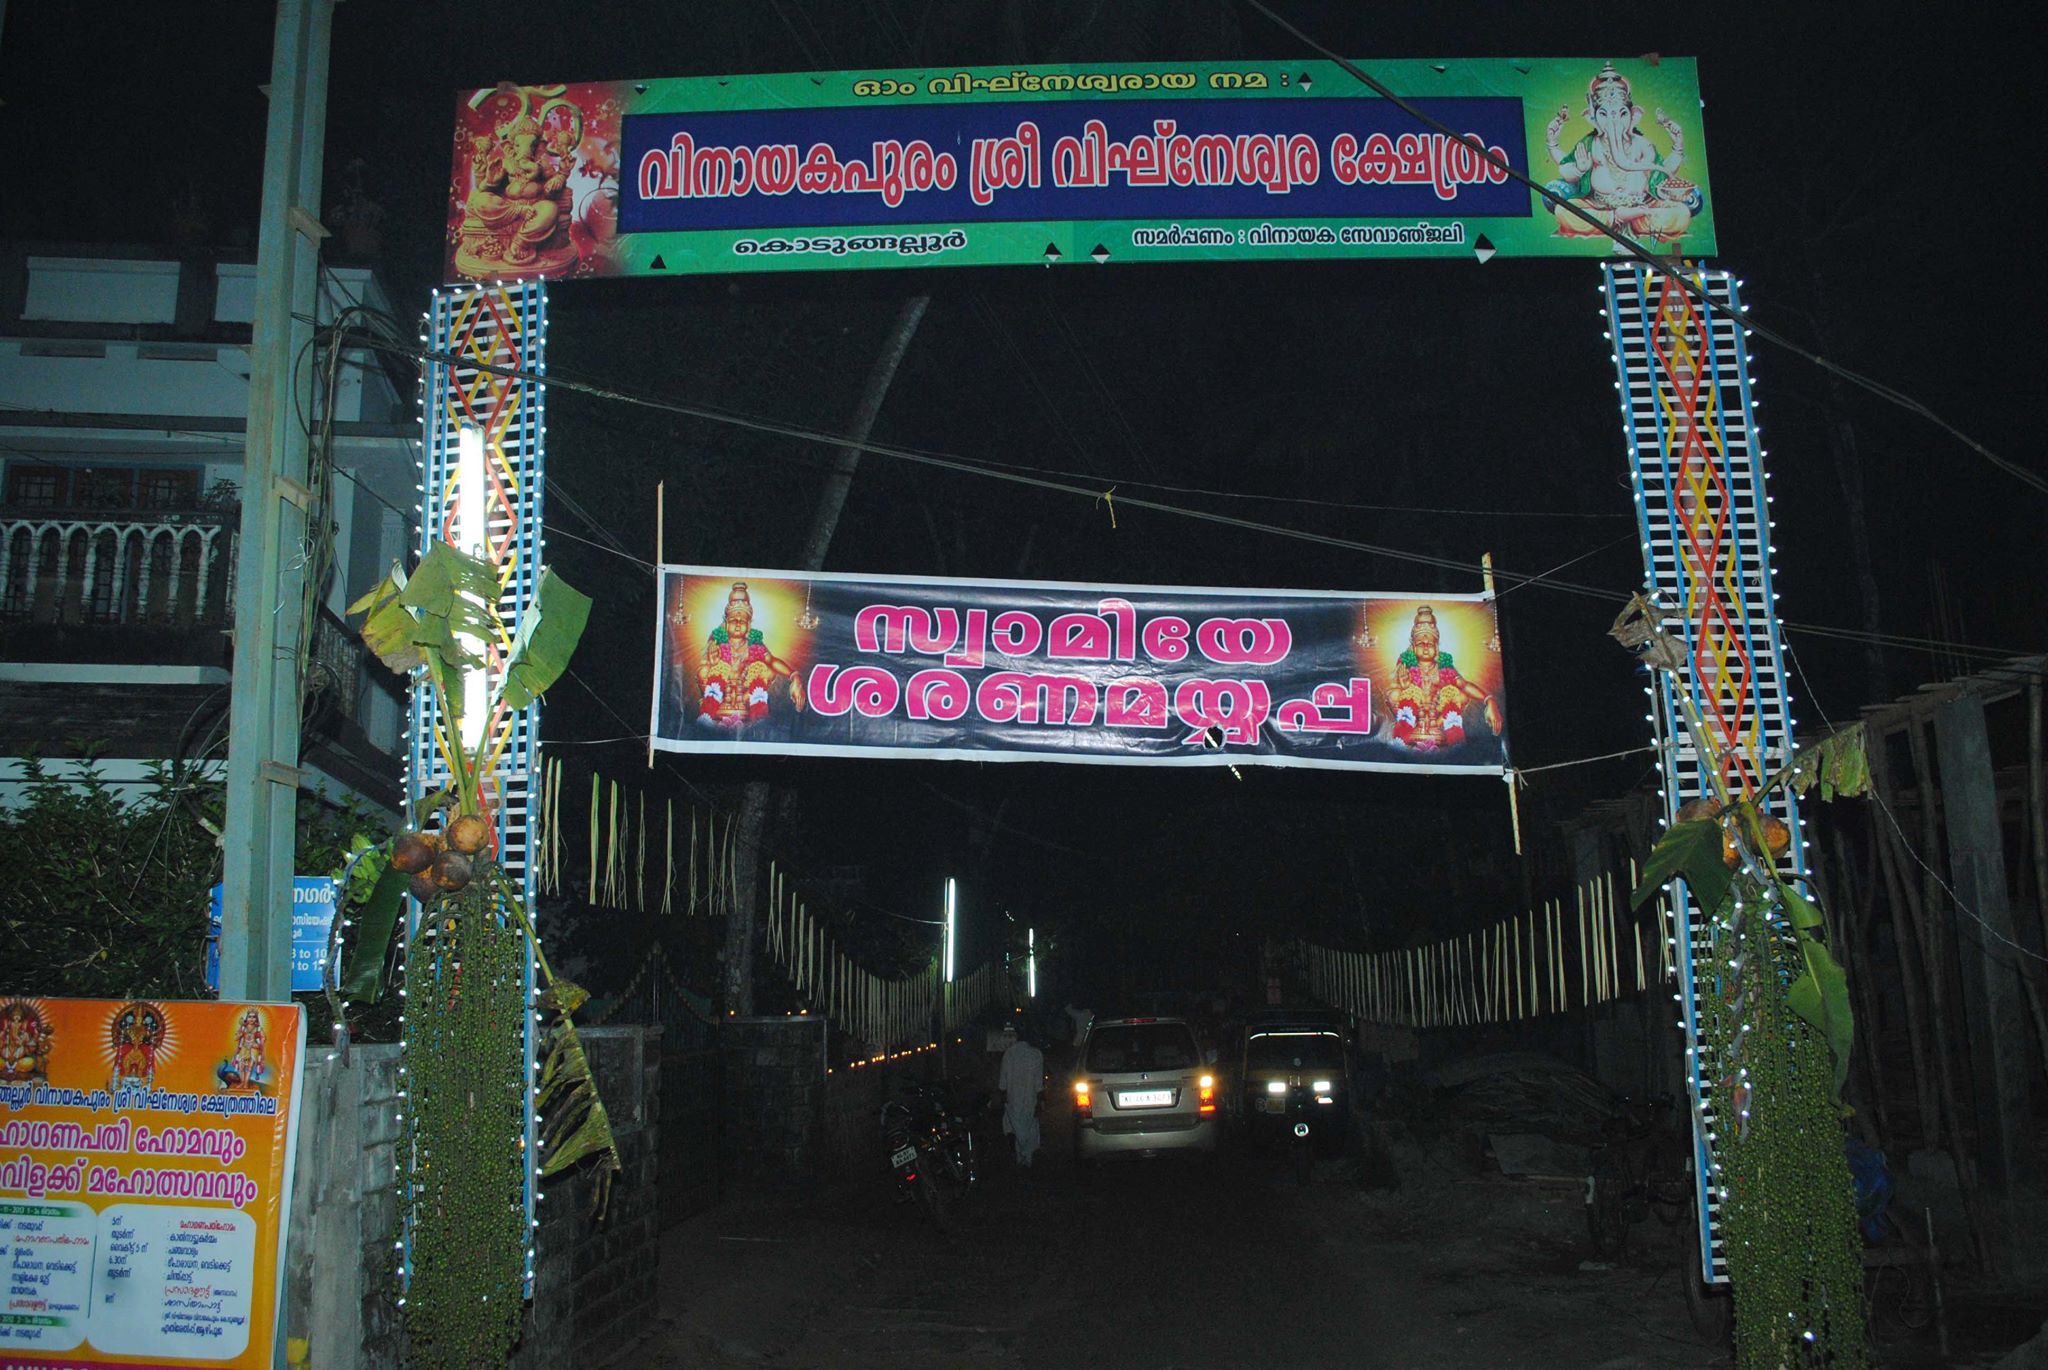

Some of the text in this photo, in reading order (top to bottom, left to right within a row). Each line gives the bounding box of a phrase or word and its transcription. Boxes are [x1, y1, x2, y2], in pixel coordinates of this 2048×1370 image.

[853, 78, 916, 97] ഓം
[639, 131, 957, 207] വിനായകപുരം
[970, 120, 1041, 206] ശ്രീ
[1331, 132, 1510, 201] ക്ഷേത്രം
[733, 229, 968, 256] കൊടുങ്ങല്ലൂർ
[1132, 224, 1234, 245] സമർപ്പണം
[1248, 224, 1337, 244] വിനായക
[853, 597, 1293, 669] സ്വാമിയേ
[806, 662, 1372, 748] ശരണമയ്യപ്പ
[35, 1083, 110, 1112] വിനായകപുരം
[135, 1124, 246, 1165] ഹോമവും
[0, 1154, 258, 1210] വിളക്ക് മഹോത്സവവും
